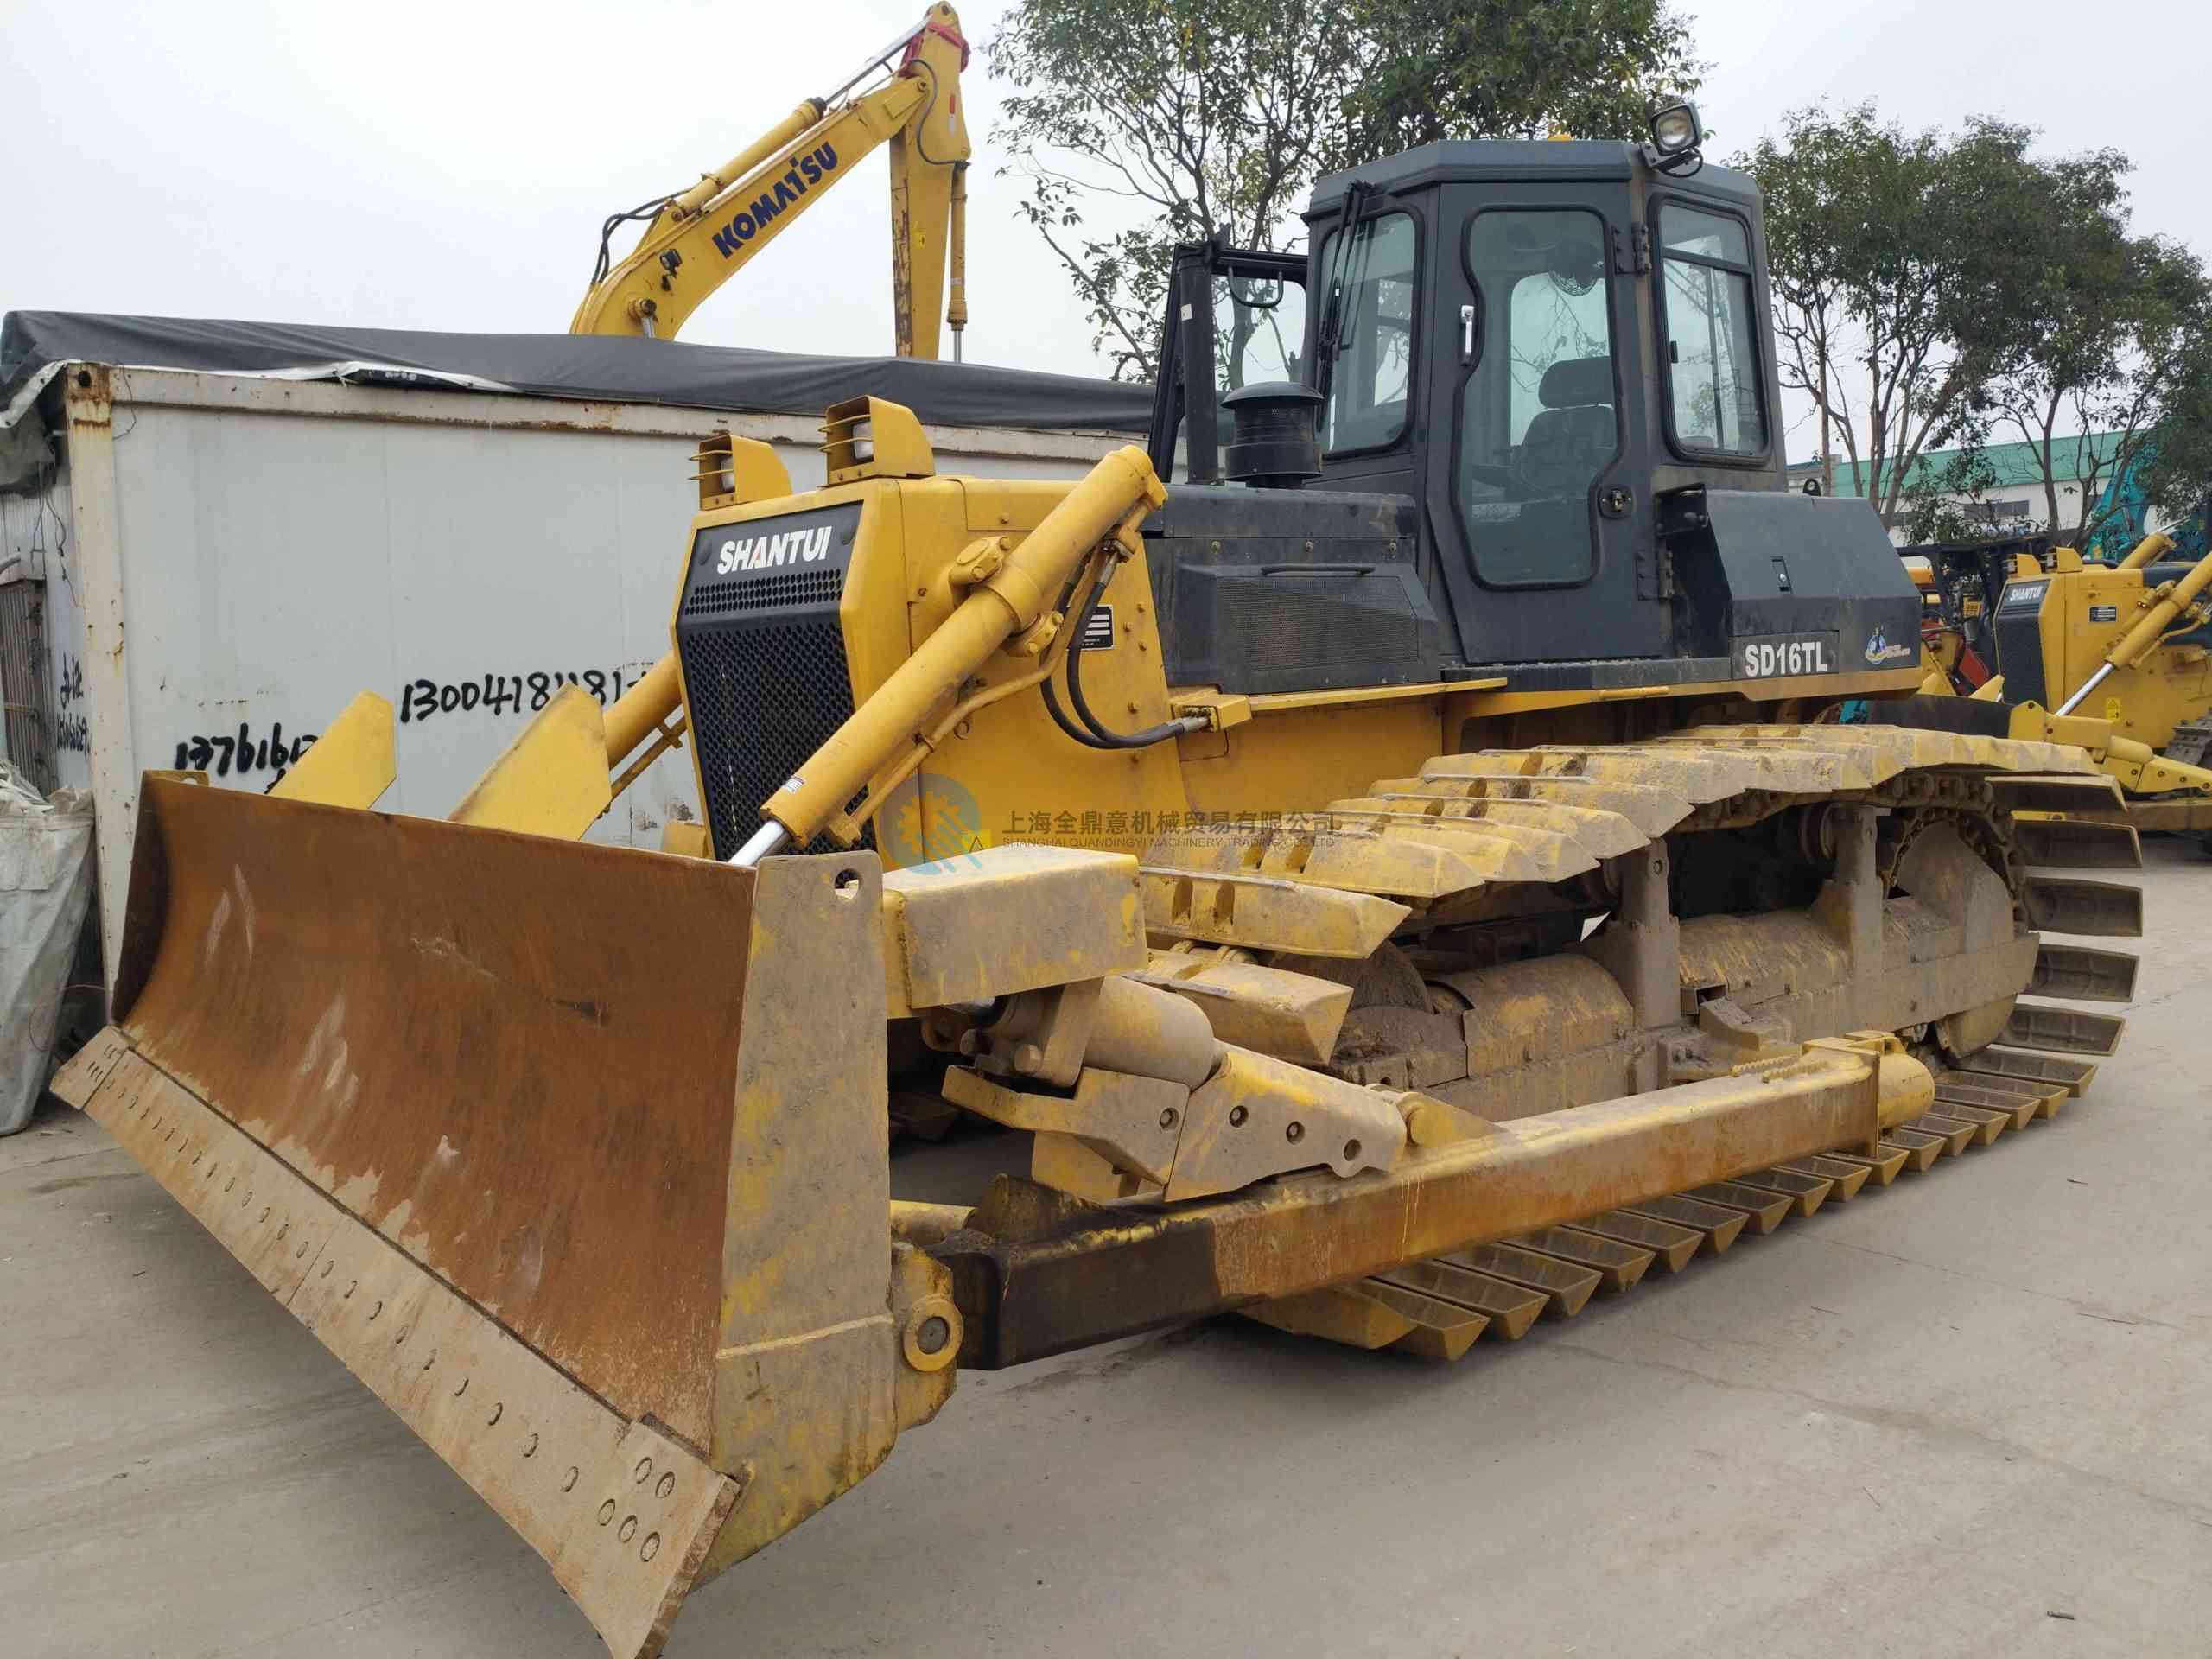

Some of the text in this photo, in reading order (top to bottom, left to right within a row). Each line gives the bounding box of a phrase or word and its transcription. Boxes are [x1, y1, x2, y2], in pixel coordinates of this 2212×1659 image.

[712, 141, 838, 259] KOMATSU
[717, 526, 832, 575] SHANTUI
[1745, 642, 1828, 677] SD16TL
